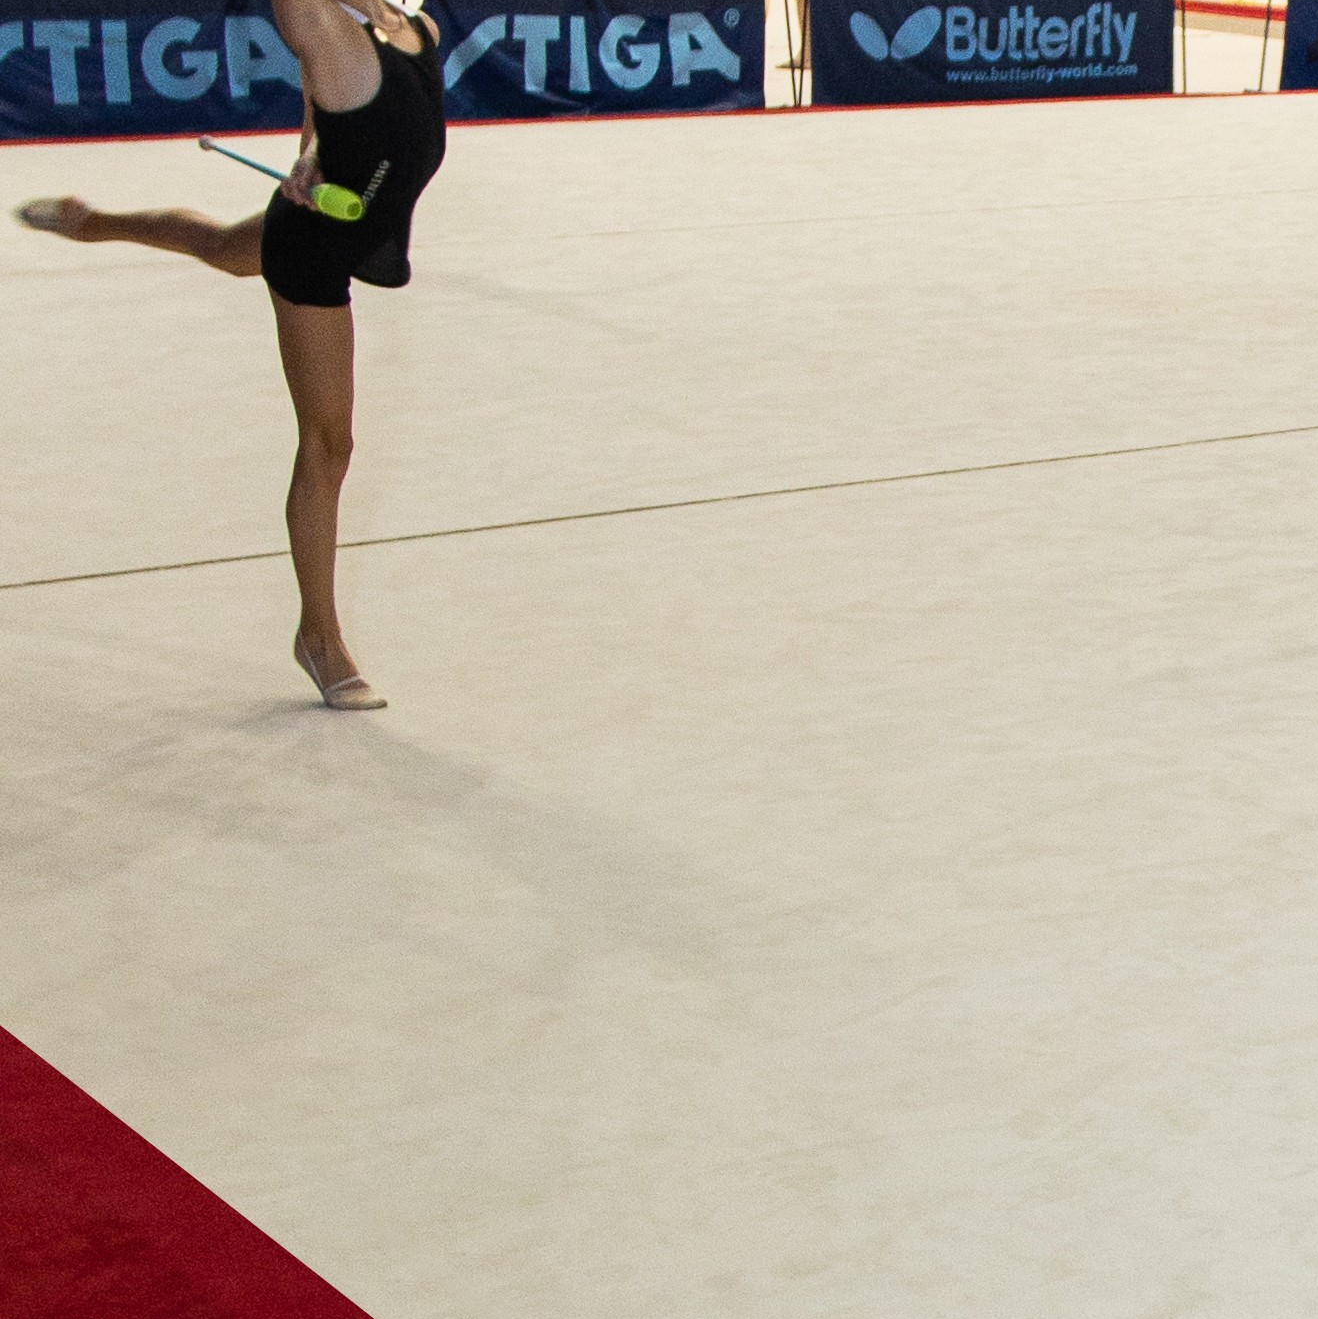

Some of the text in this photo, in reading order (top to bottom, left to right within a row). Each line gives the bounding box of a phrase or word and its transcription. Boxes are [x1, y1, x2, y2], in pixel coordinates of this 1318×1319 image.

[0, 15, 302, 104] TIGA
[945, 1, 1138, 63] Butterfly
[946, 63, 1138, 83] www.butterfly-world.com
